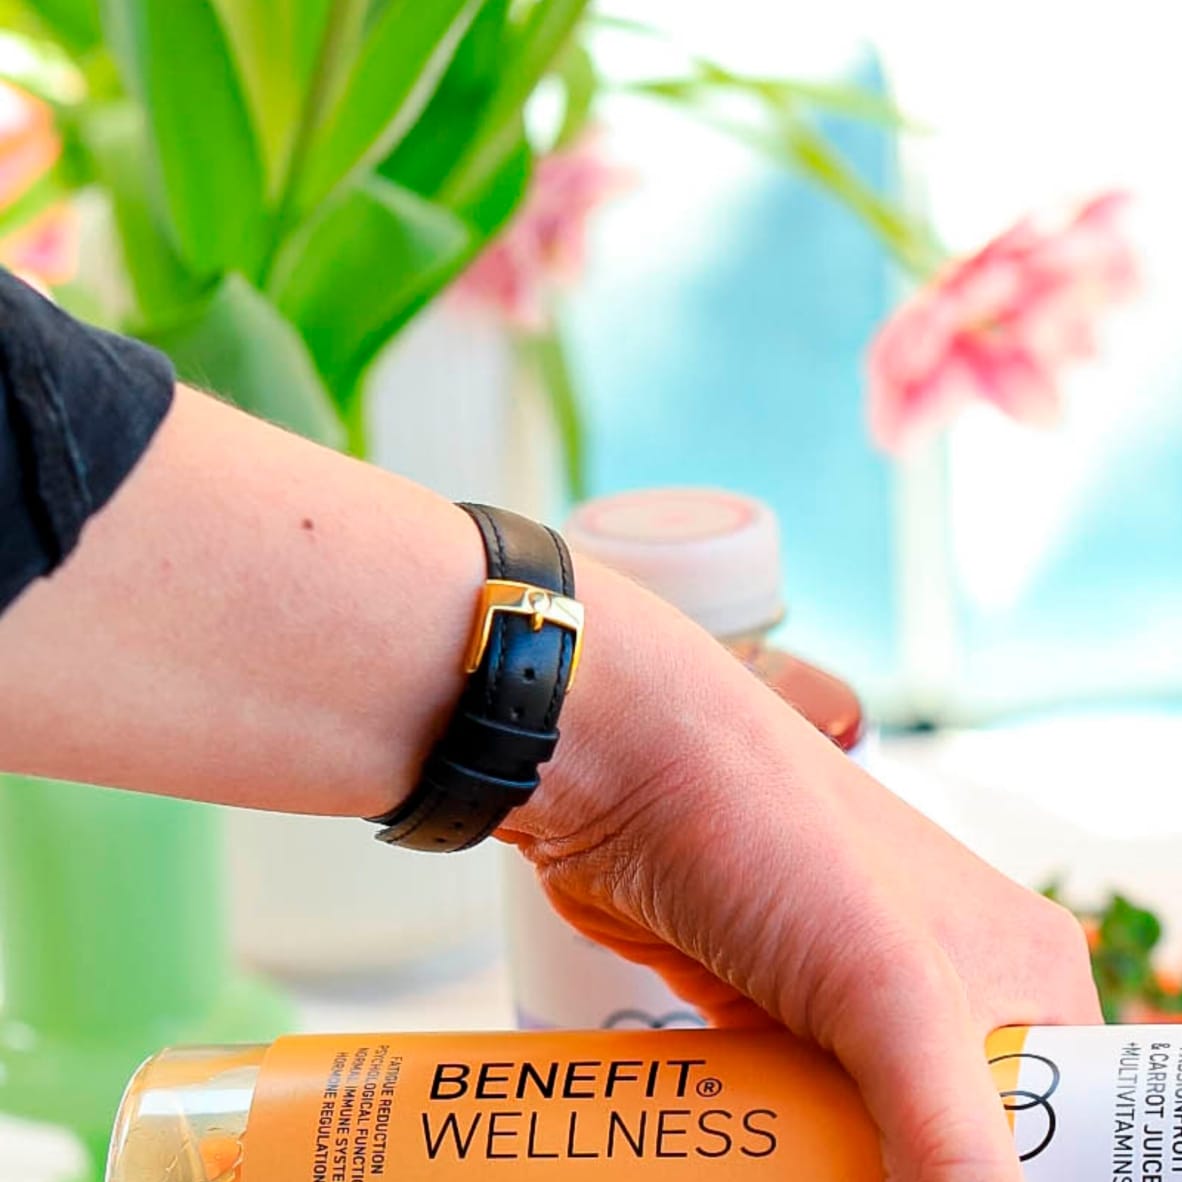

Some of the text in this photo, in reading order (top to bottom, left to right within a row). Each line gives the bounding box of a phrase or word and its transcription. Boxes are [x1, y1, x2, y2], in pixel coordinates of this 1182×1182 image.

[324, 1052, 349, 1098] HORMONE
[347, 1047, 369, 1083] NORMAL
[357, 1045, 390, 1125] PSYCHOLOGICAL
[1145, 1053, 1169, 1118] CARROT
[337, 1086, 358, 1134] IMMUNE
[370, 1056, 402, 1175] FATIGUE REDUCTION
[421, 1109, 778, 1160] WELLNESS
